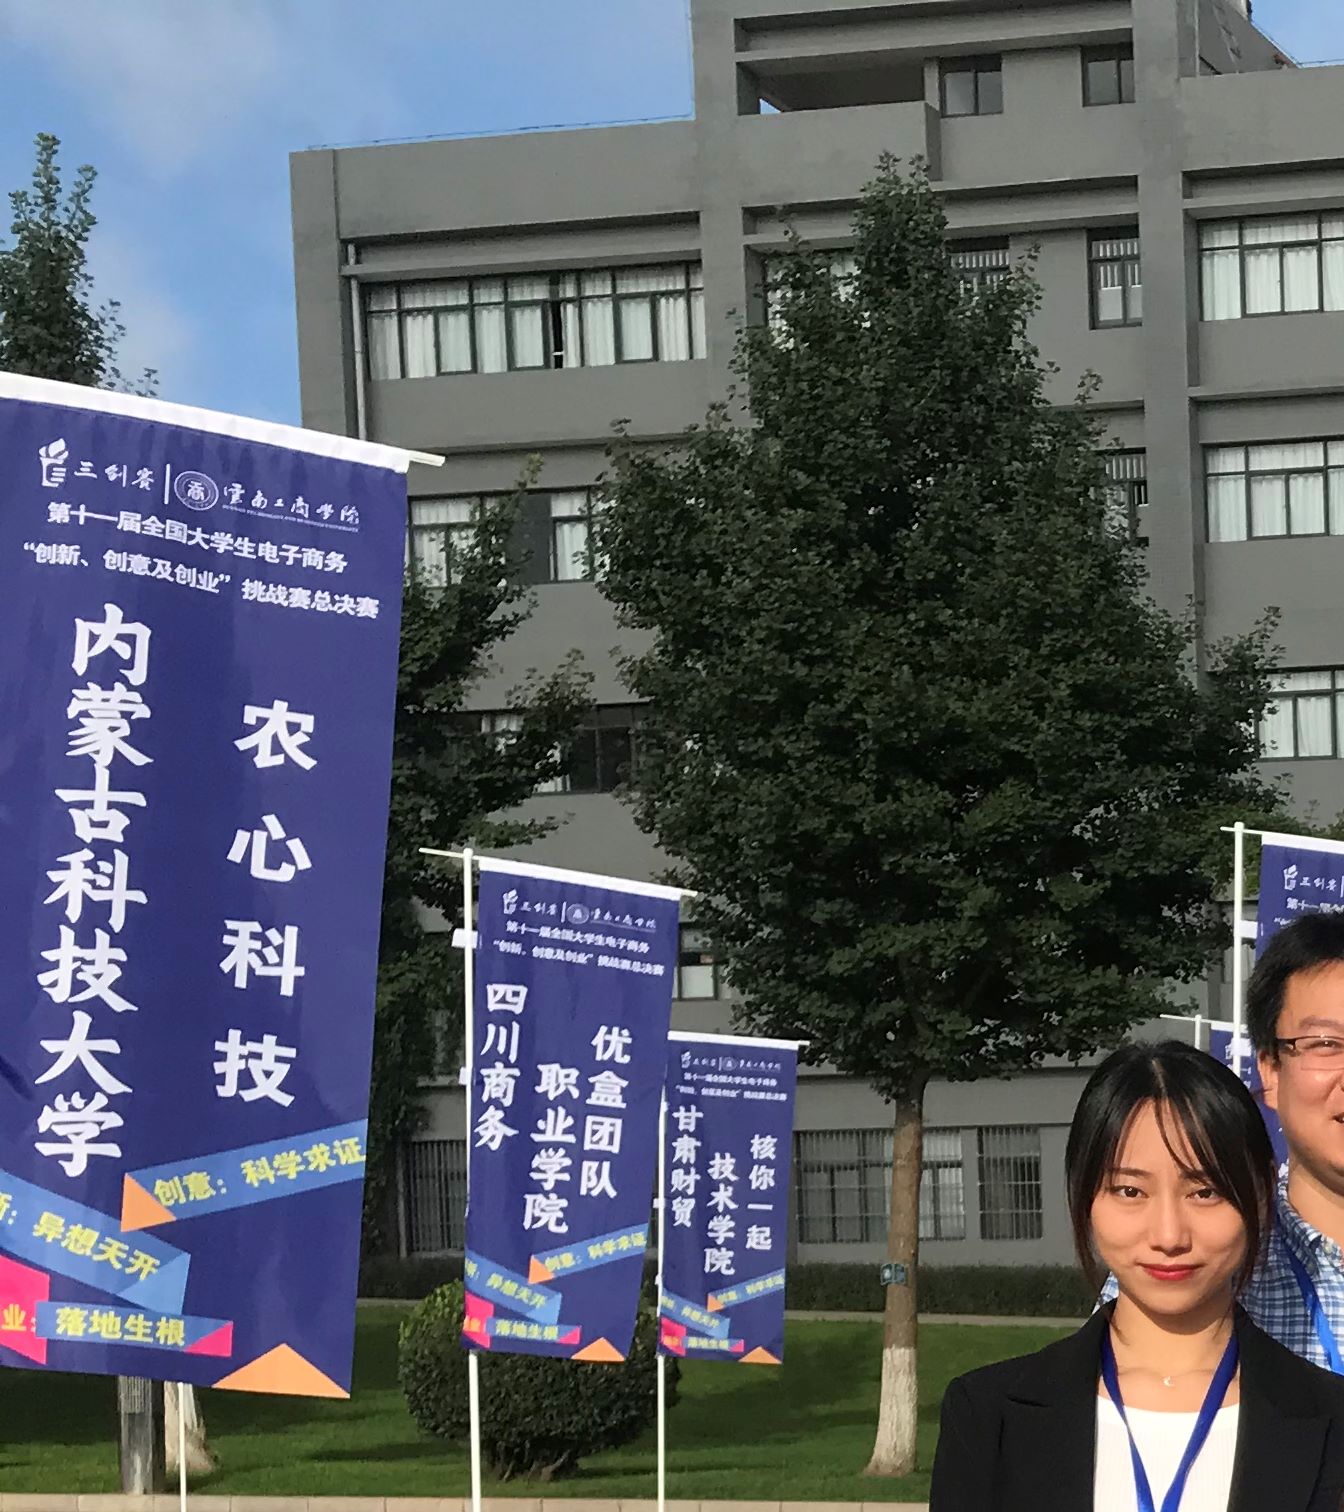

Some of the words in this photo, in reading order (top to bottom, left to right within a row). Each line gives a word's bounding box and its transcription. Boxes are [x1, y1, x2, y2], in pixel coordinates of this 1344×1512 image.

[47, 502, 348, 574] 第十一届全国大学生电子商务
[33, 603, 153, 1178] 内蒙古科技大学
[213, 698, 318, 1108] 农心科技
[474, 983, 528, 1151] 四川商务
[522, 1063, 580, 1234] 职业学院
[580, 1024, 632, 1199] 优盒团队
[671, 1105, 703, 1228] 甘肃财贸
[704, 1153, 739, 1275] 技术学院
[746, 1134, 777, 1250] 核你一起
